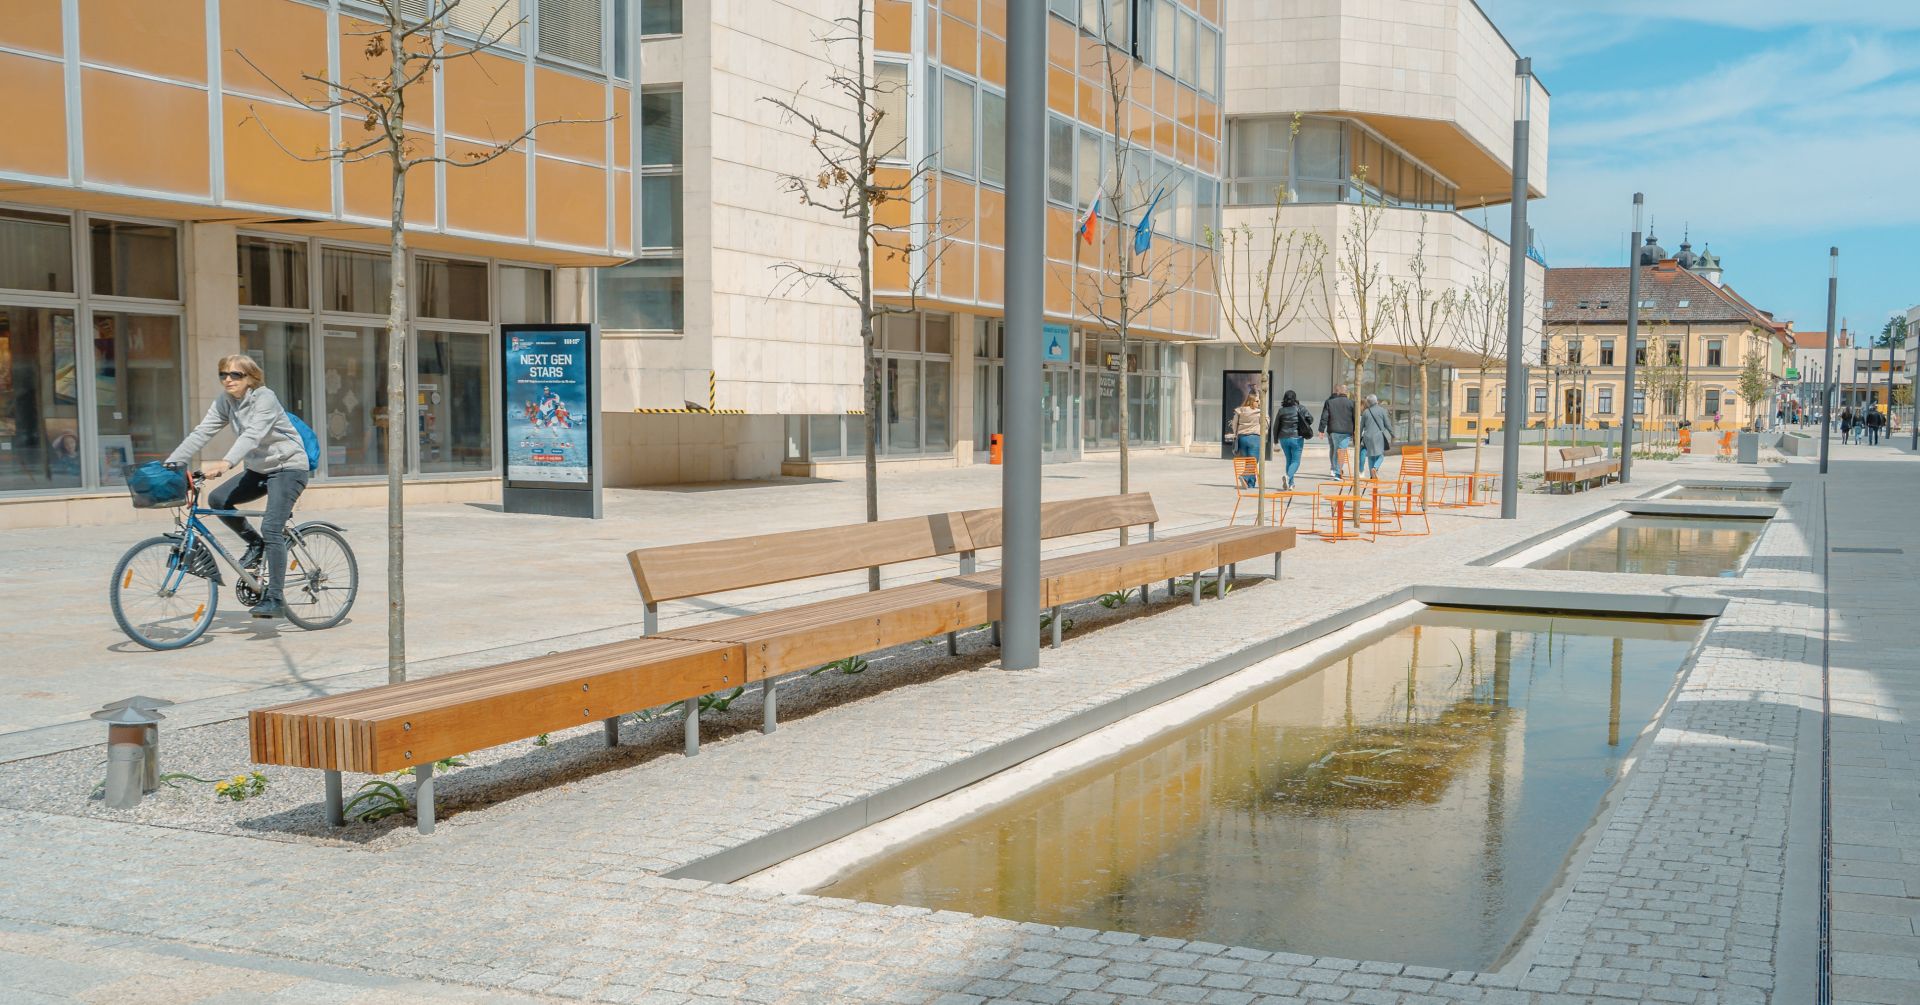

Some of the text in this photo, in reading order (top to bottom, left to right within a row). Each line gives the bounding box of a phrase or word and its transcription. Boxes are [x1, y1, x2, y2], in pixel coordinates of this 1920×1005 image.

[520, 354, 572, 365] NEXT GEN
[529, 366, 564, 378] STARS
